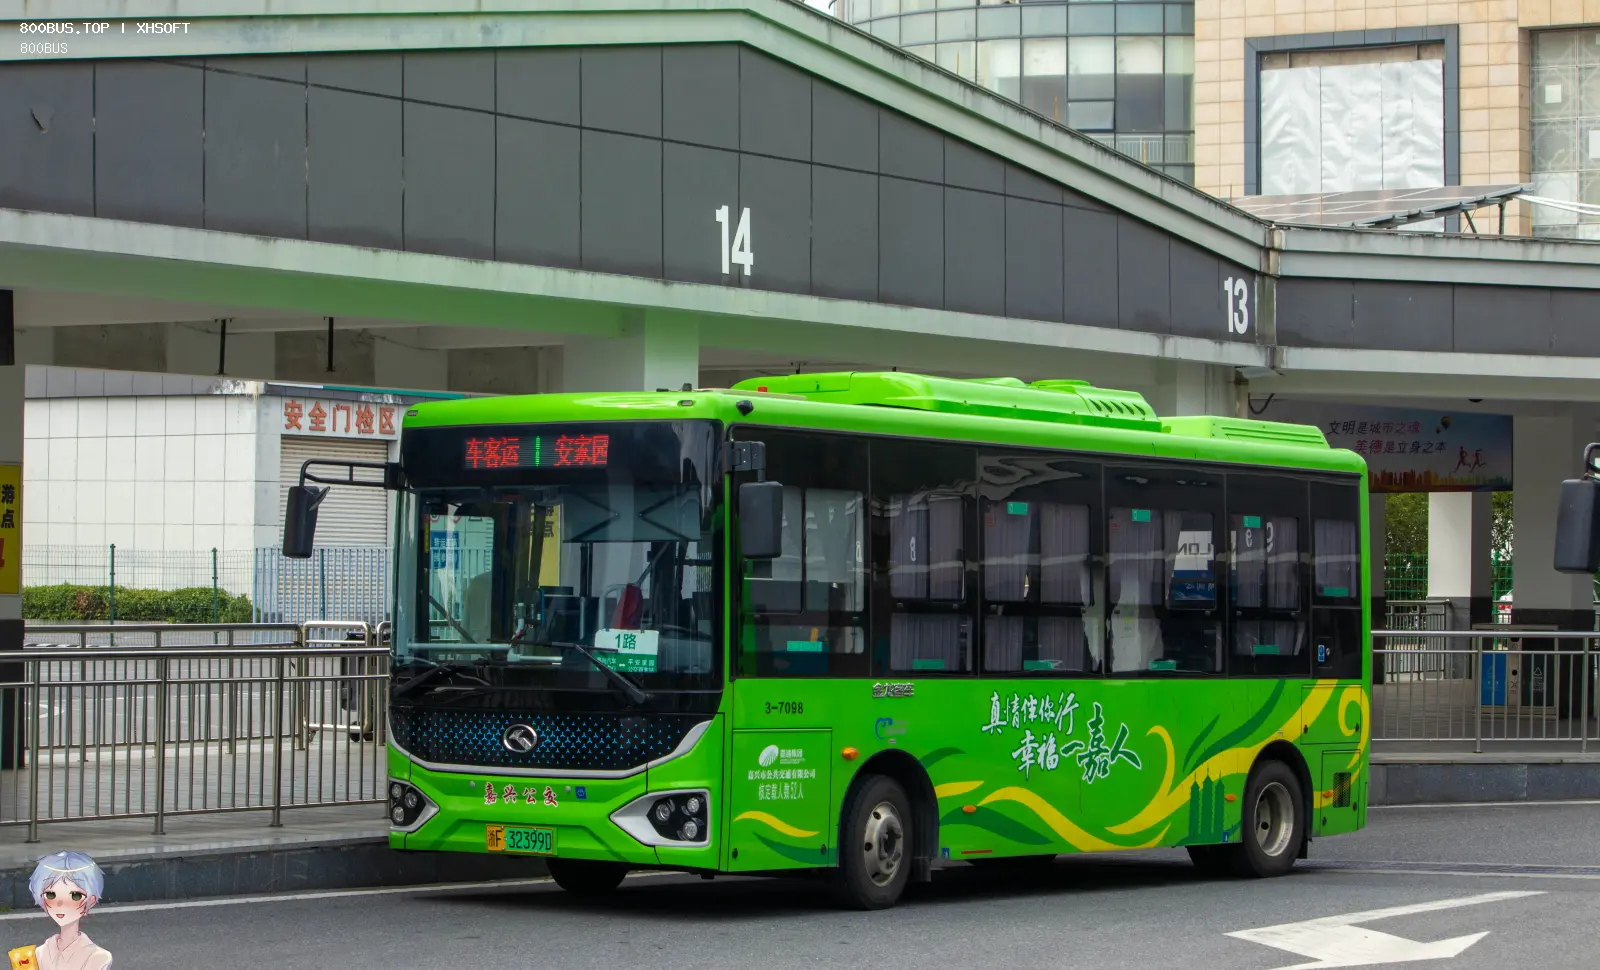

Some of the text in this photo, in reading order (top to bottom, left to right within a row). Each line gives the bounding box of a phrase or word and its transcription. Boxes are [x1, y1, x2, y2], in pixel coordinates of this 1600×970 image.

[715, 205, 754, 276] 14
[1224, 276, 1249, 335] 13
[284, 399, 396, 435] 安全门检区
[1327, 420, 1421, 436] 文明是城市之魂
[465, 436, 520, 468] 车客运
[554, 434, 609, 466] 安家园
[1354, 439, 1447, 455] 美德是立身之本
[615, 633, 637, 650] 1路
[765, 702, 804, 714] 3-7098
[981, 691, 1080, 735] 真情伴你行
[1011, 702, 1142, 784] 幸福一嘉人
[748, 768, 816, 780] 嘉兴市公共交通有限公司
[484, 782, 558, 807] 嘉兴公交
